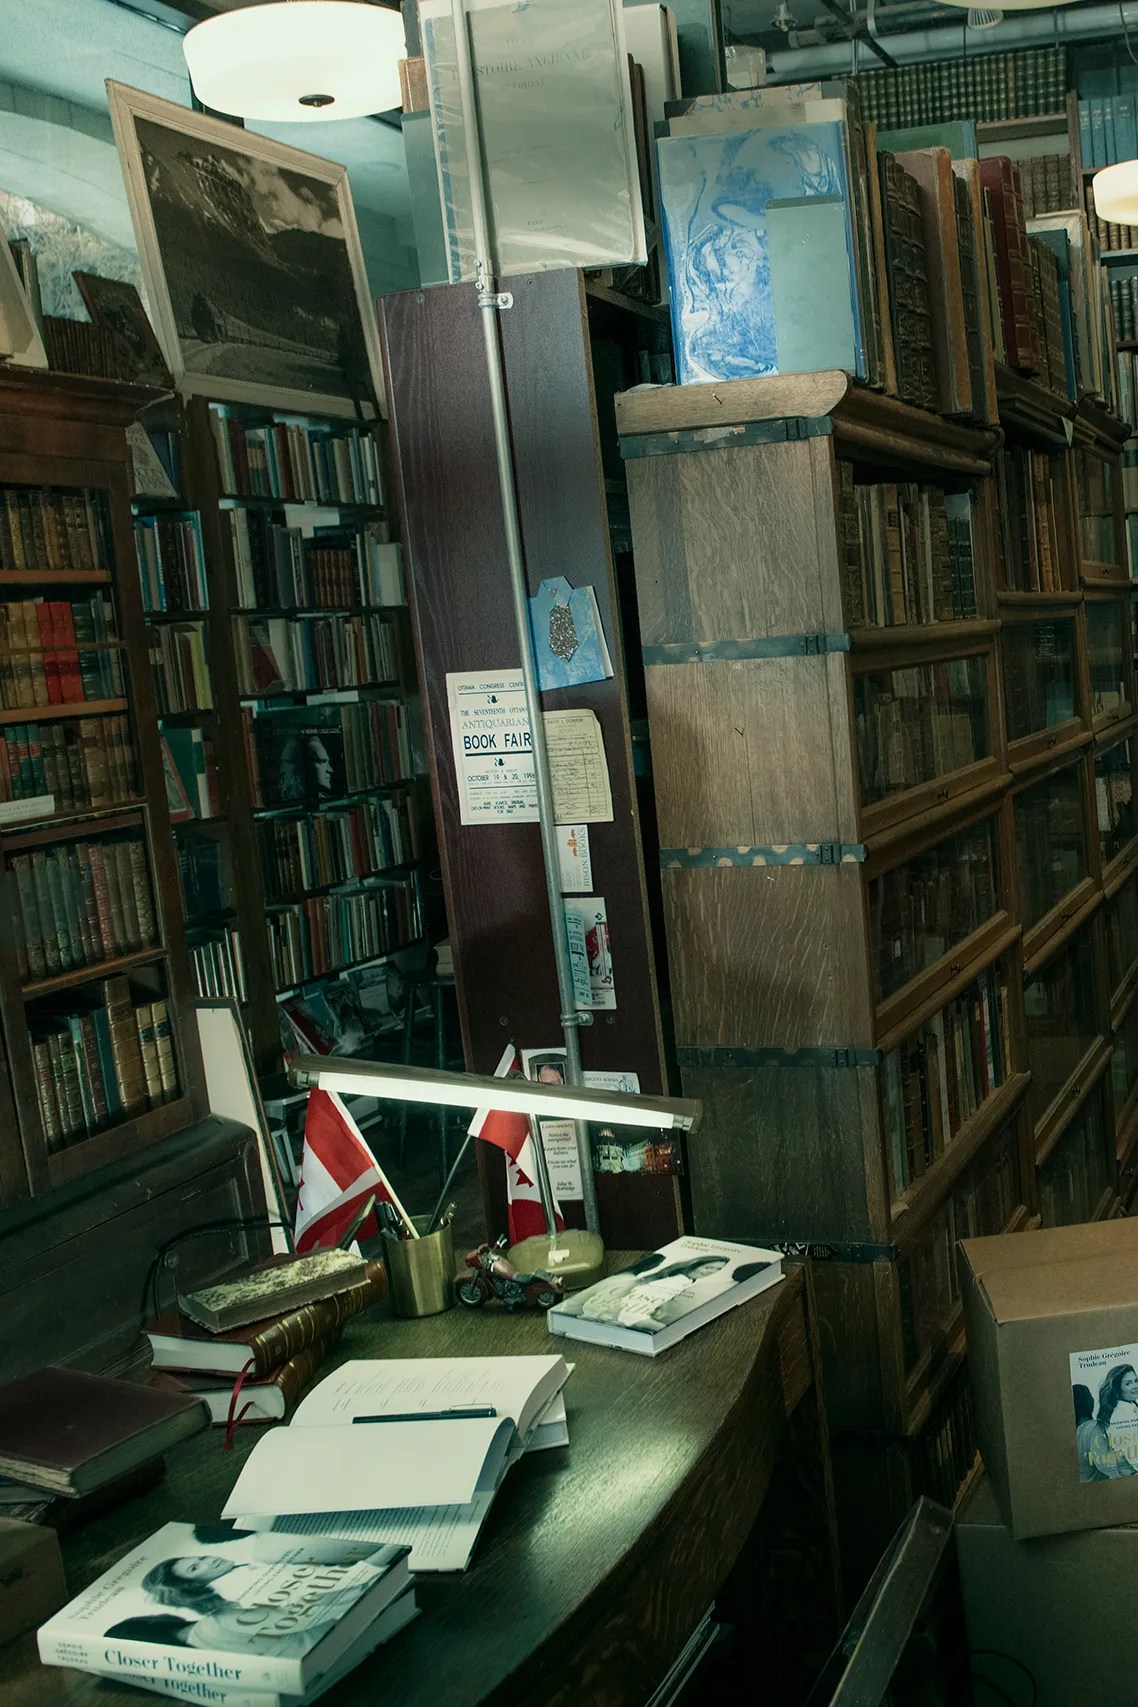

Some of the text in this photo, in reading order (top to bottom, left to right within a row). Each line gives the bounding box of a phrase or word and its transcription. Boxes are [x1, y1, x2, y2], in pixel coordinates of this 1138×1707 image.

[479, 682, 505, 690] CONGRESS
[462, 718, 529, 730] ANTIQUARIAN
[463, 734, 497, 750] BOOK
[504, 732, 532, 747] FAIR
[467, 774, 489, 782] OCTOBER
[1078, 1354, 1100, 1363] Sophie
[1078, 1360, 1107, 1369] Trudeau
[236, 1557, 316, 1626] Close
[104, 1649, 242, 1681] Closer Together
